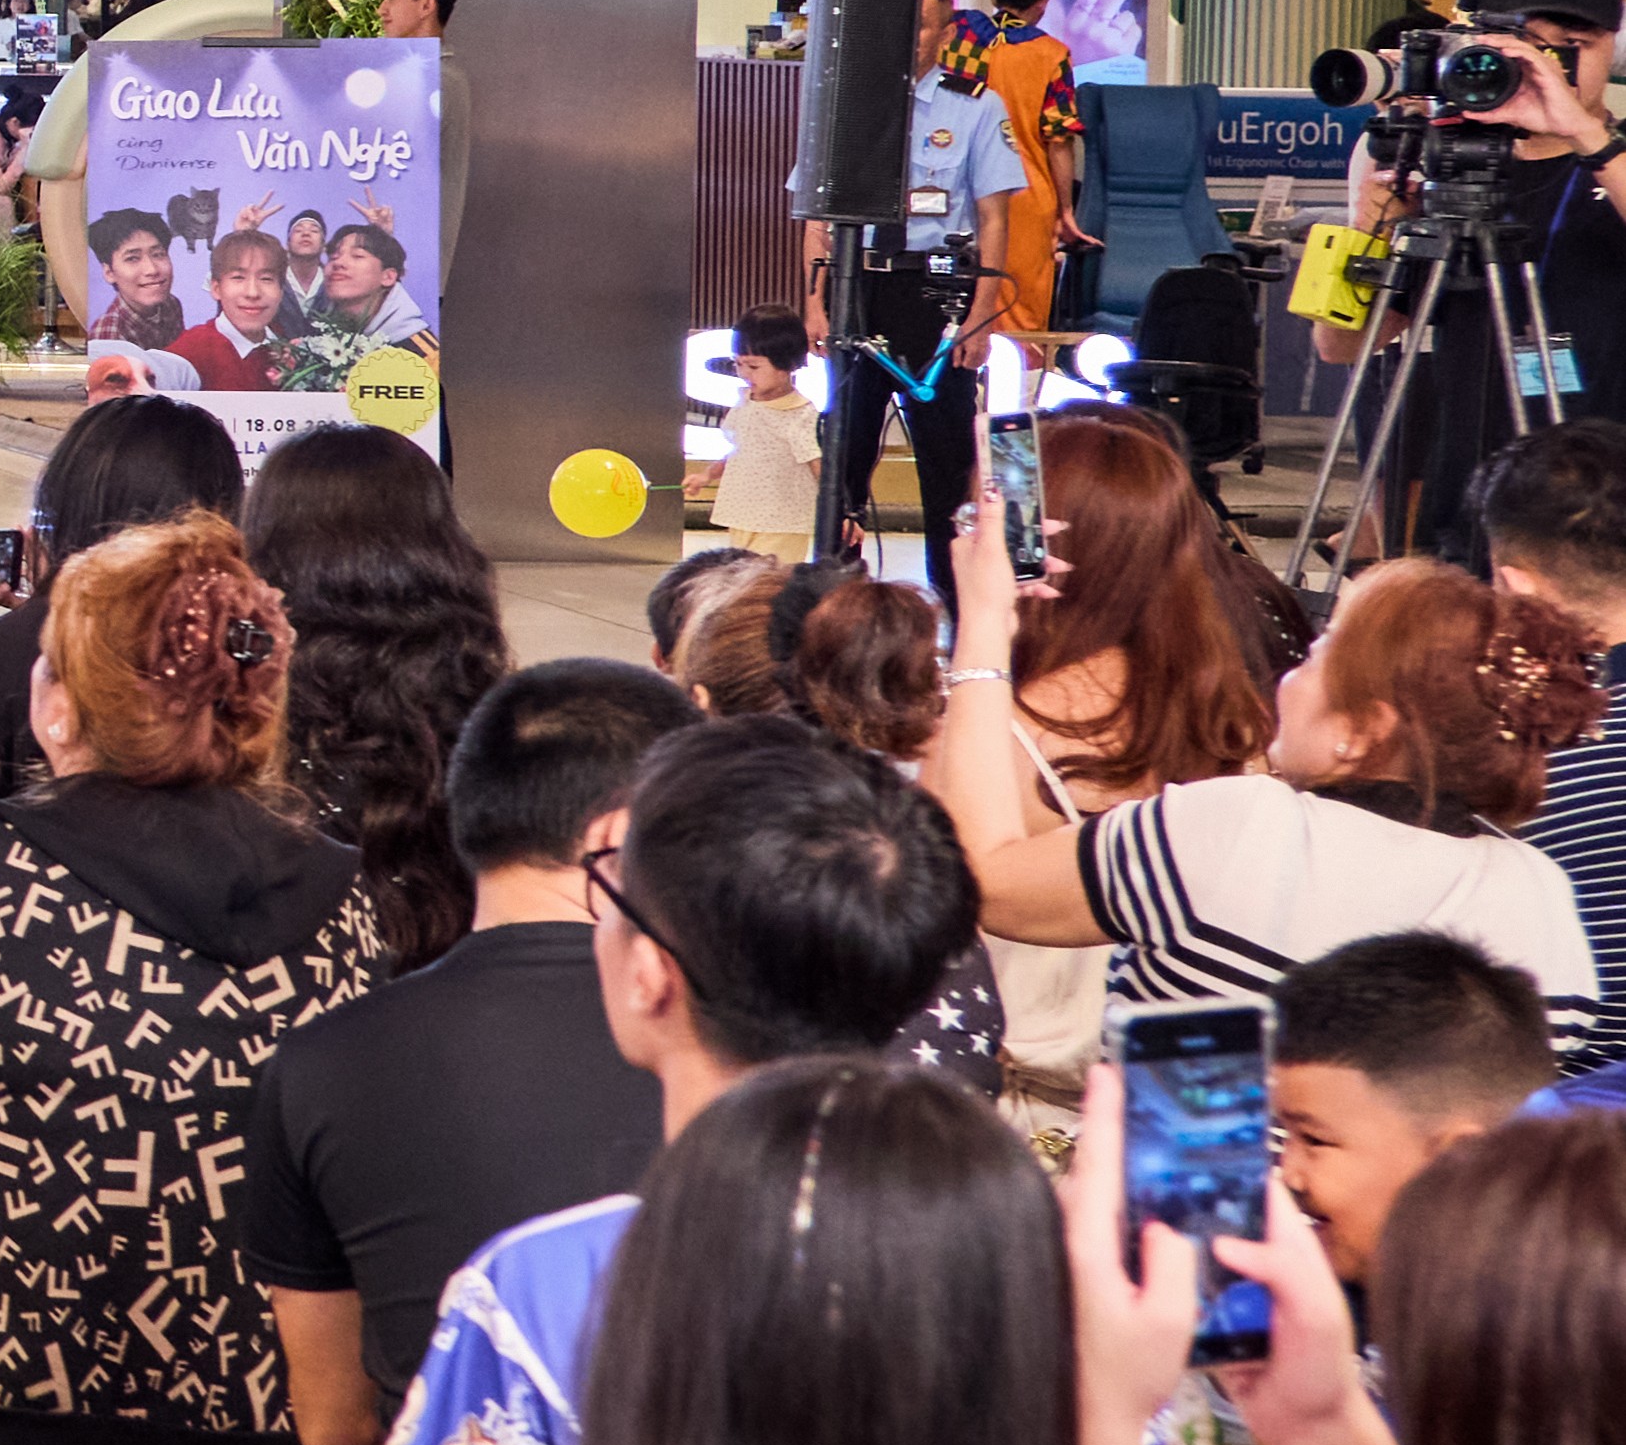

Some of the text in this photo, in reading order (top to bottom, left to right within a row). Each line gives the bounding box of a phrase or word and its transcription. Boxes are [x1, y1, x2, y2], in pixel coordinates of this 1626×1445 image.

[110, 76, 280, 120] Giao Lưu
[1218, 112, 1343, 154] uErgoh
[117, 135, 164, 152] cùng
[116, 154, 217, 171] Duniverse
[237, 127, 412, 181] Văn Nghệ
[1225, 156, 1286, 170] Ergonomic
[1288, 156, 1318, 168] Chair
[358, 385, 425, 400] FREE
